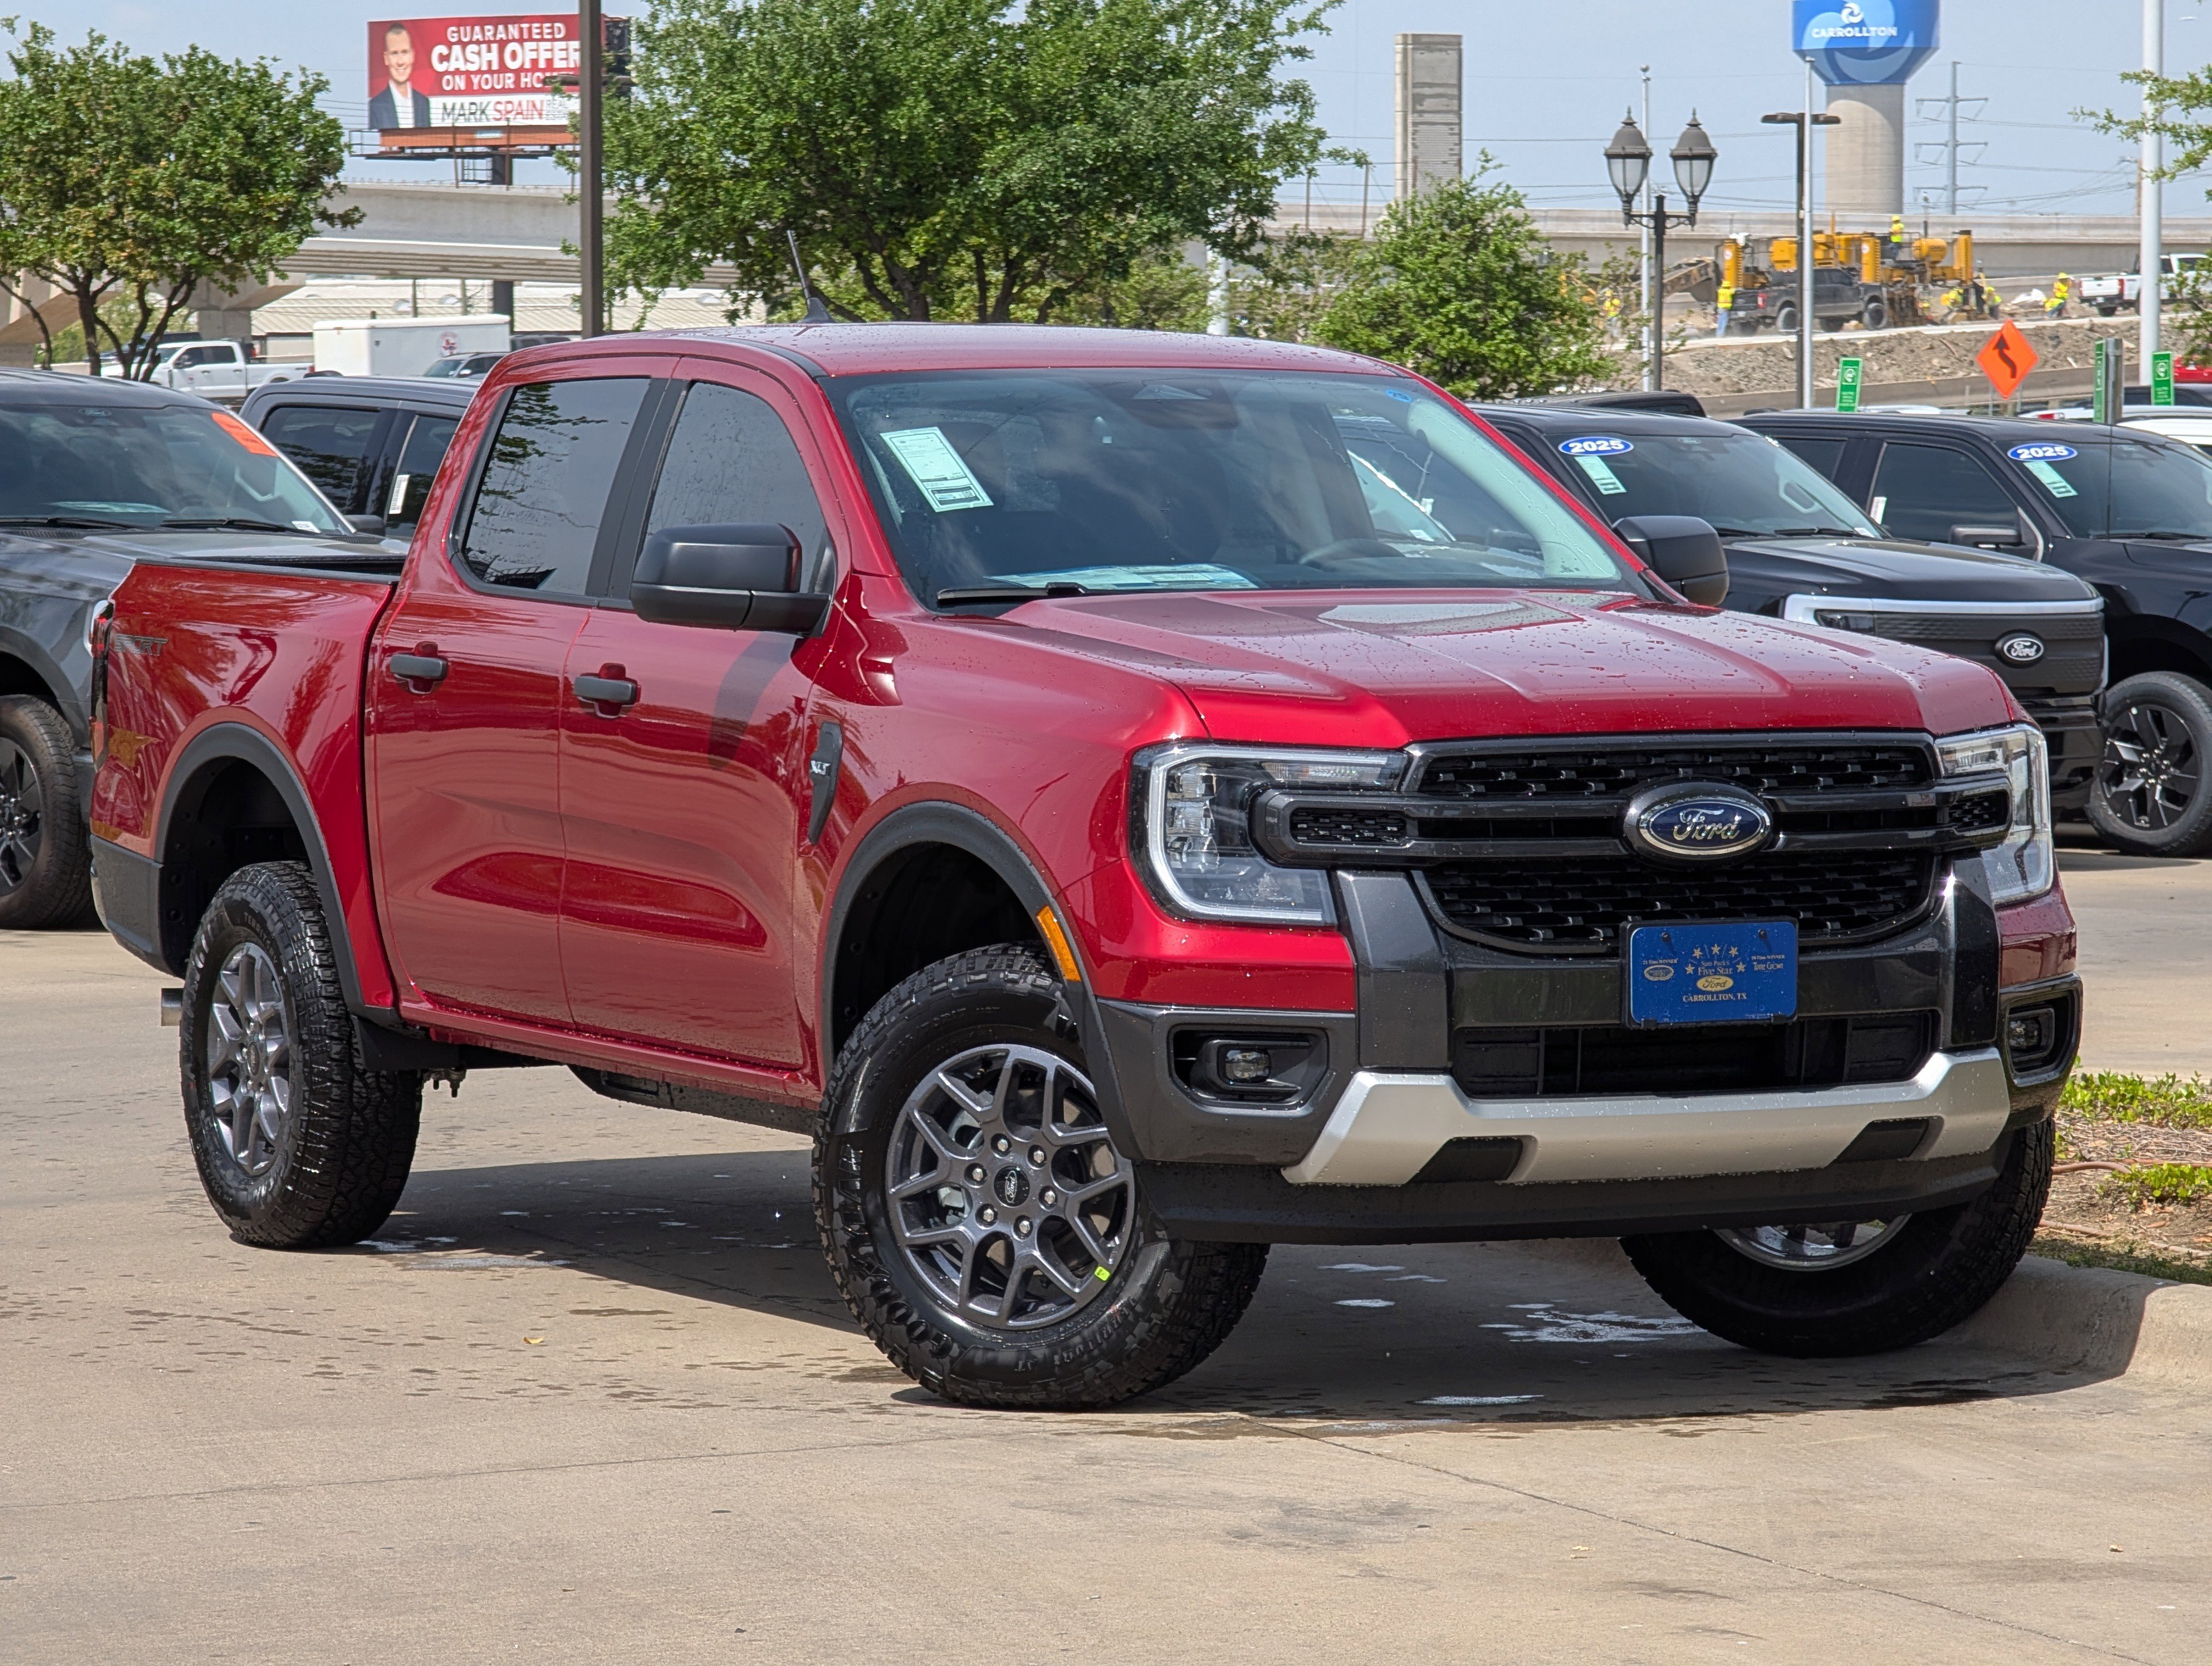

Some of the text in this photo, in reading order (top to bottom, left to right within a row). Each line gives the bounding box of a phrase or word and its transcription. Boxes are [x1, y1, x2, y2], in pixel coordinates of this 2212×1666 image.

[447, 22, 566, 42] GUARANTEED
[1811, 27, 1898, 38] CARROLLTON
[430, 40, 581, 72] CASH OFFER
[441, 74, 466, 91] ON
[470, 73, 515, 90] YOUR
[441, 99, 544, 123] MARK SPAIN
[1568, 440, 1625, 453] 2025
[2017, 446, 2069, 459] 2025
[114, 633, 169, 657] SPORT
[2010, 641, 2037, 656] Ford
[1673, 808, 1740, 841] Ford
[1697, 966, 1733, 976] Five Star
[1702, 977, 1728, 989] Ford
[1682, 992, 1747, 1003] CARROLLTON, TX
[1006, 1176, 1016, 1199] Ford
